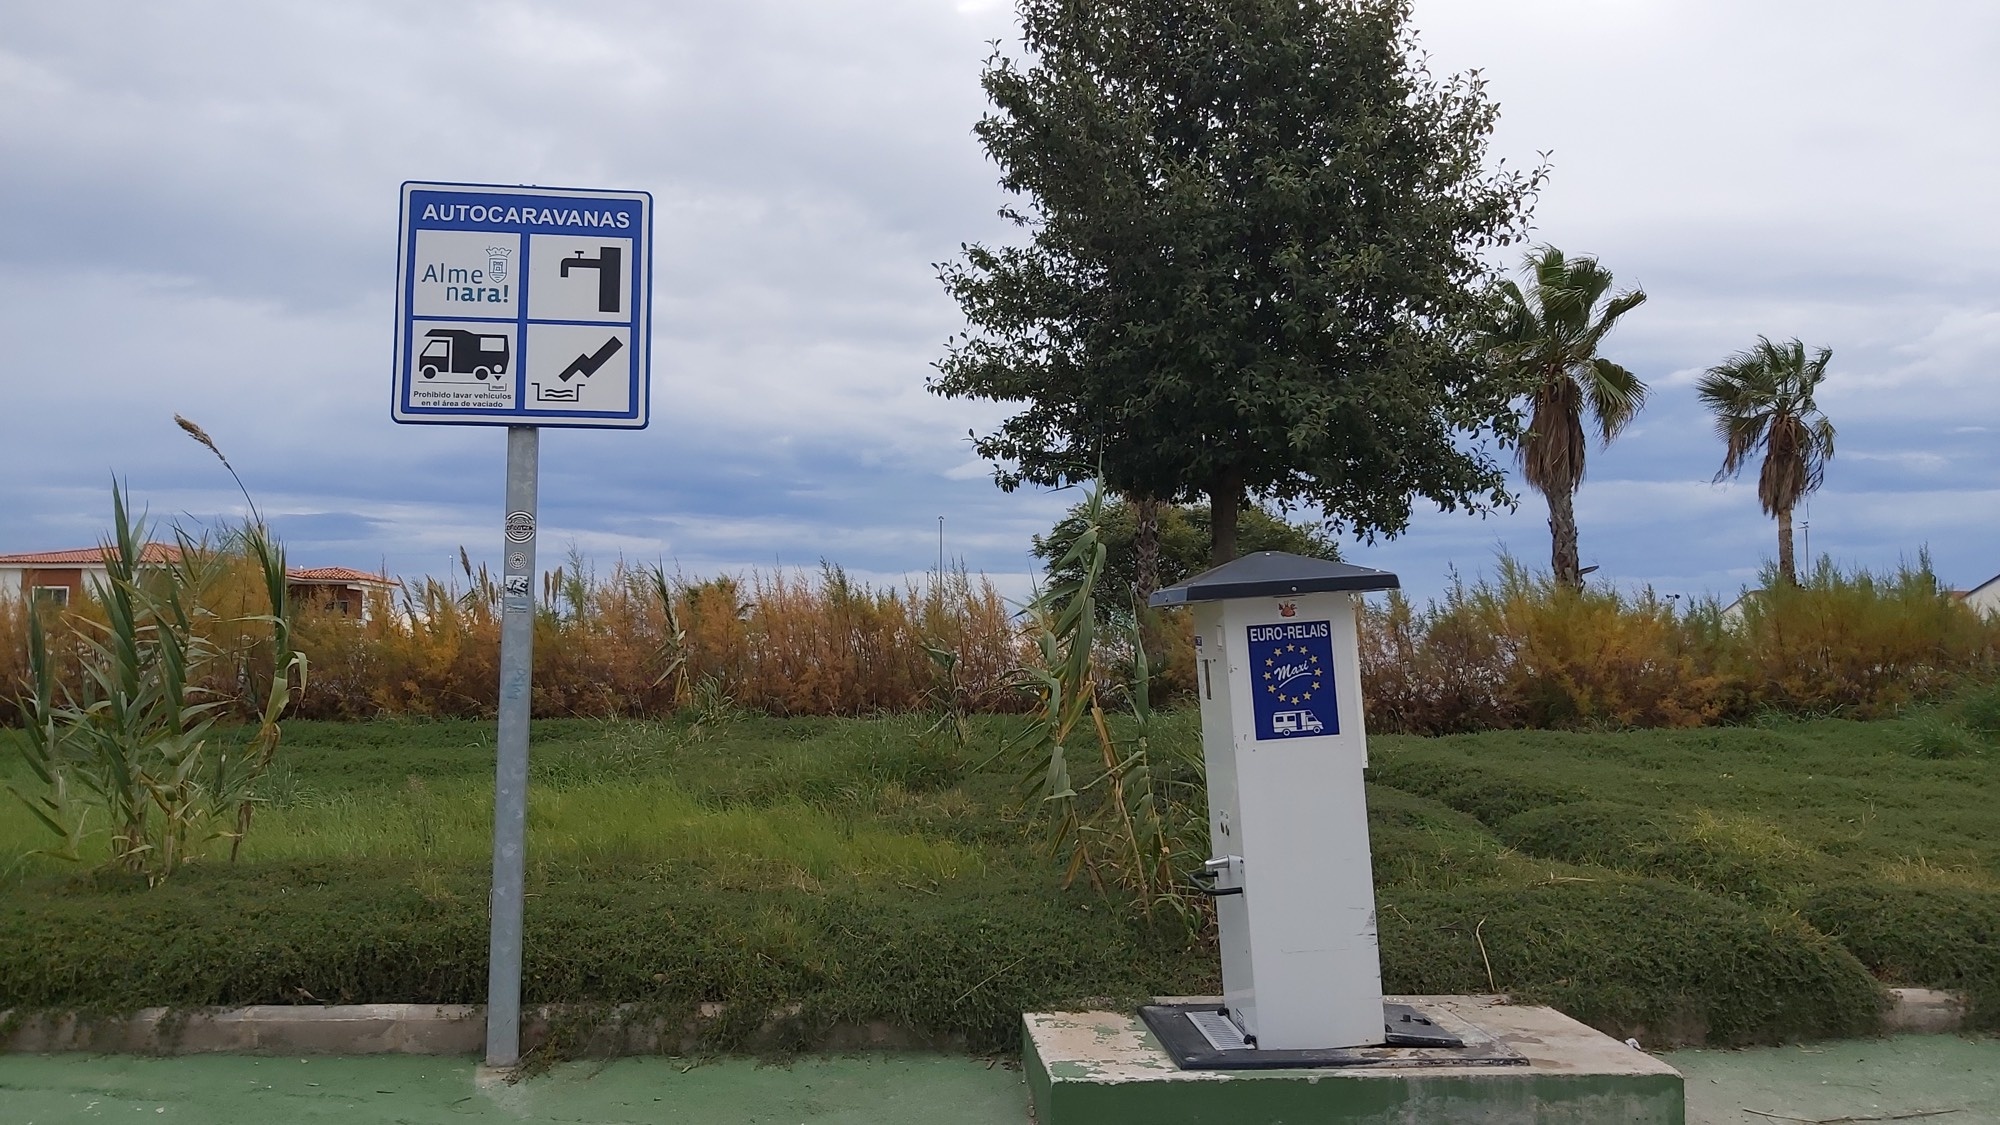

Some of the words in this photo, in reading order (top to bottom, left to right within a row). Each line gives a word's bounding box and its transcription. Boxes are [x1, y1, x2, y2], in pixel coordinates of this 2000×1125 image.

[422, 203, 630, 229] AUTOCARAVANAS
[421, 262, 483, 284] Alme
[446, 285, 509, 303] nara!
[413, 390, 451, 399] Prohibido
[453, 391, 472, 399] lavar
[442, 400, 459, 408] área
[1251, 623, 1328, 642] EURO-RELAIS
[1274, 660, 1309, 681] Maxi
